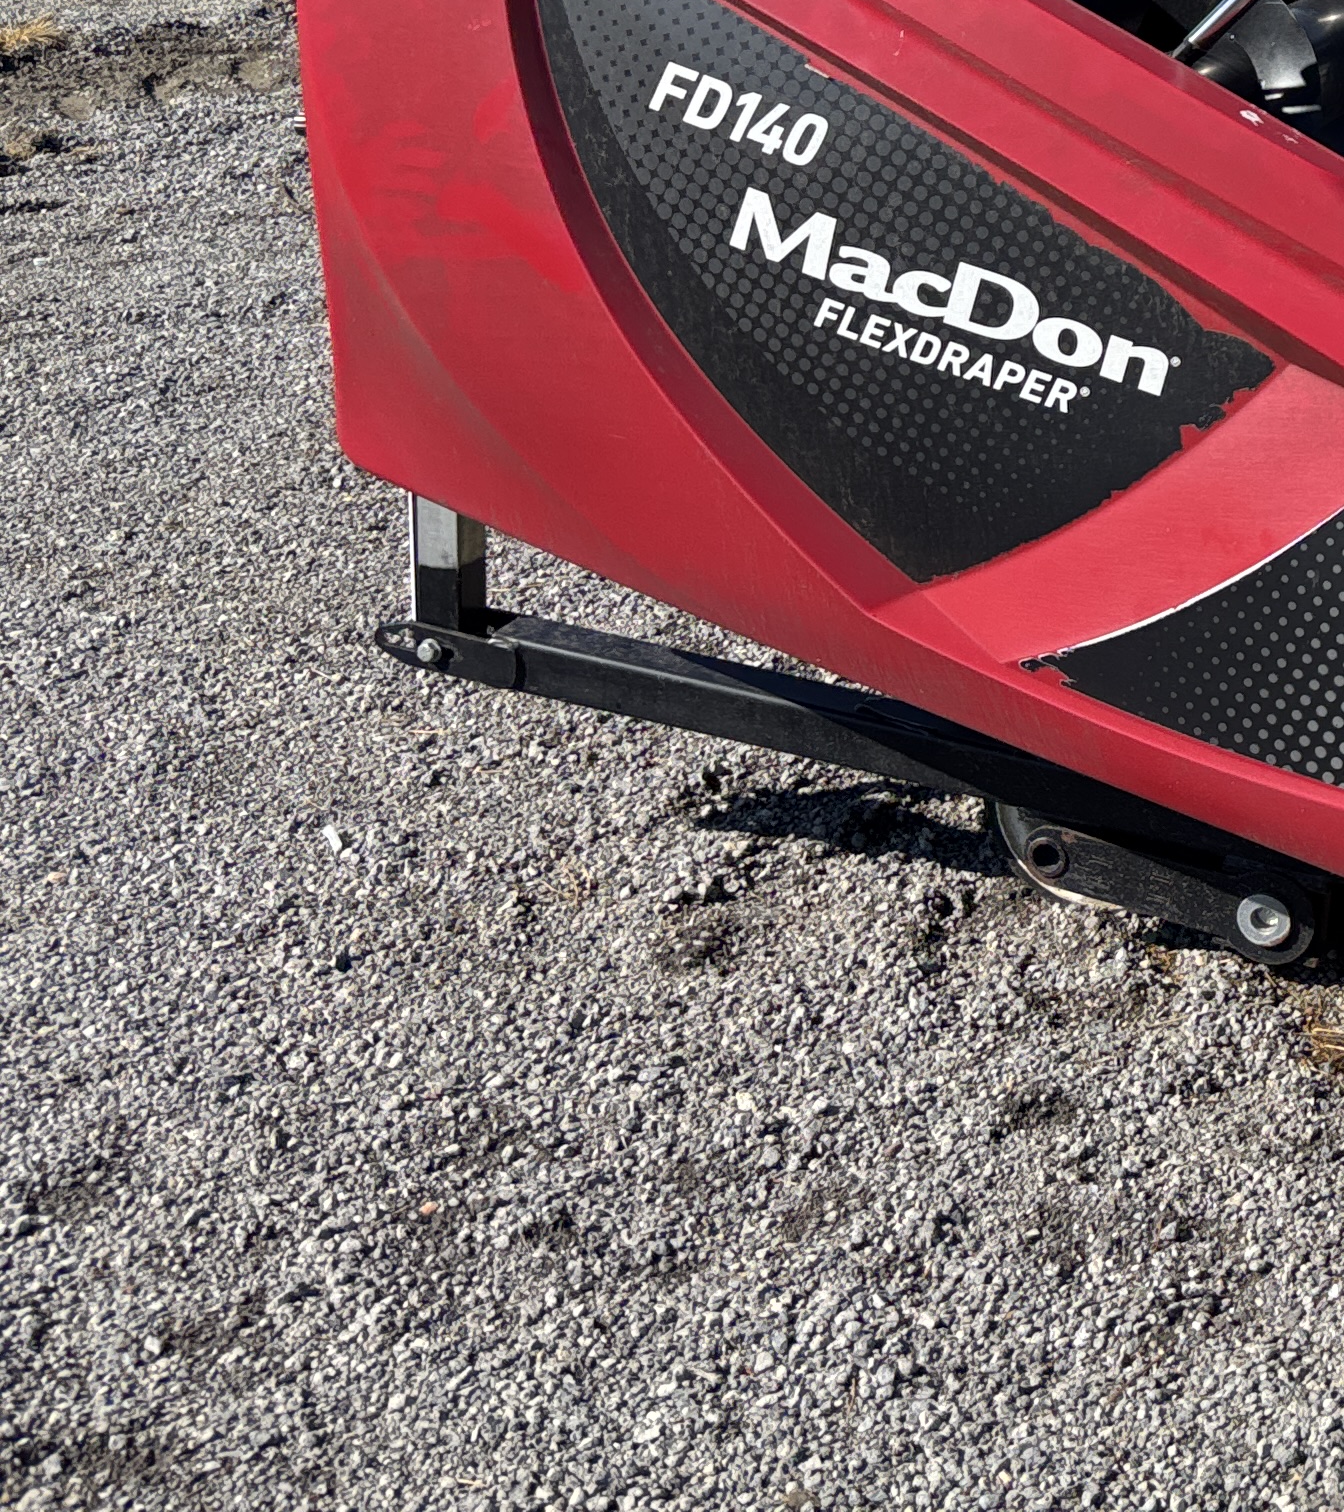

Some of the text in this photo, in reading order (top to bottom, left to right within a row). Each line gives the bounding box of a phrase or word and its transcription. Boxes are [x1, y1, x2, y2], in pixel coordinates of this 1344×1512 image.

[648, 61, 828, 166] FD140
[729, 186, 1174, 396] MacDon
[813, 297, 1079, 413] FLEXDRAPER
